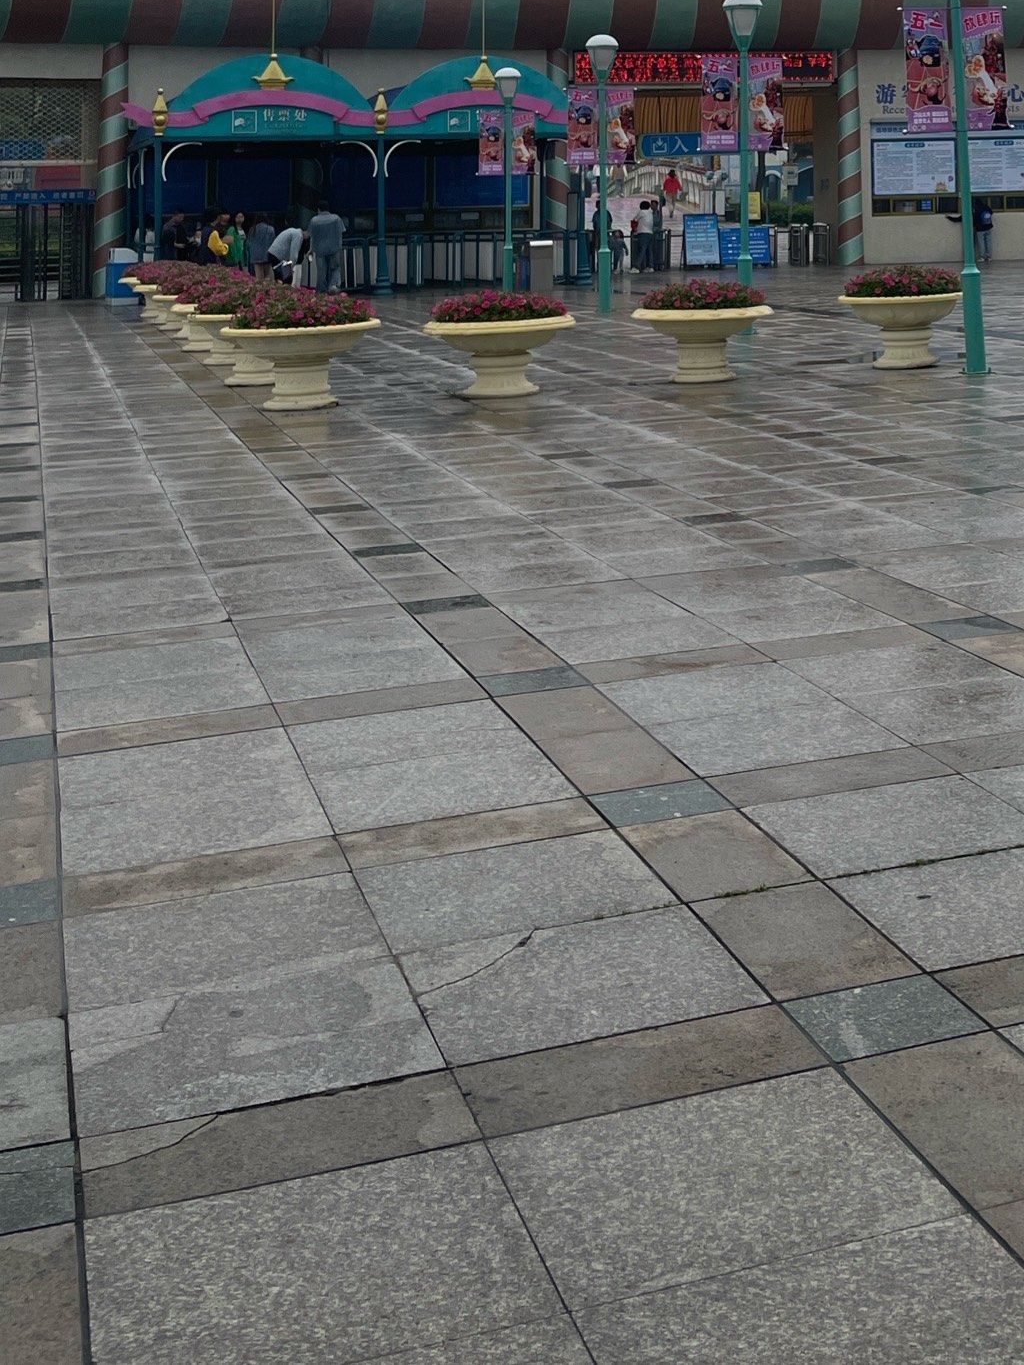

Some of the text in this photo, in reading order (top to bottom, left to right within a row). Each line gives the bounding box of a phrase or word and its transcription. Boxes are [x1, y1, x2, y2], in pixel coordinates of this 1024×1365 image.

[910, 11, 944, 31] 五一
[964, 11, 1002, 32] 放肆玩
[708, 59, 735, 73] 五一
[263, 108, 307, 122] 售票处
[882, 105, 906, 115] Rece
